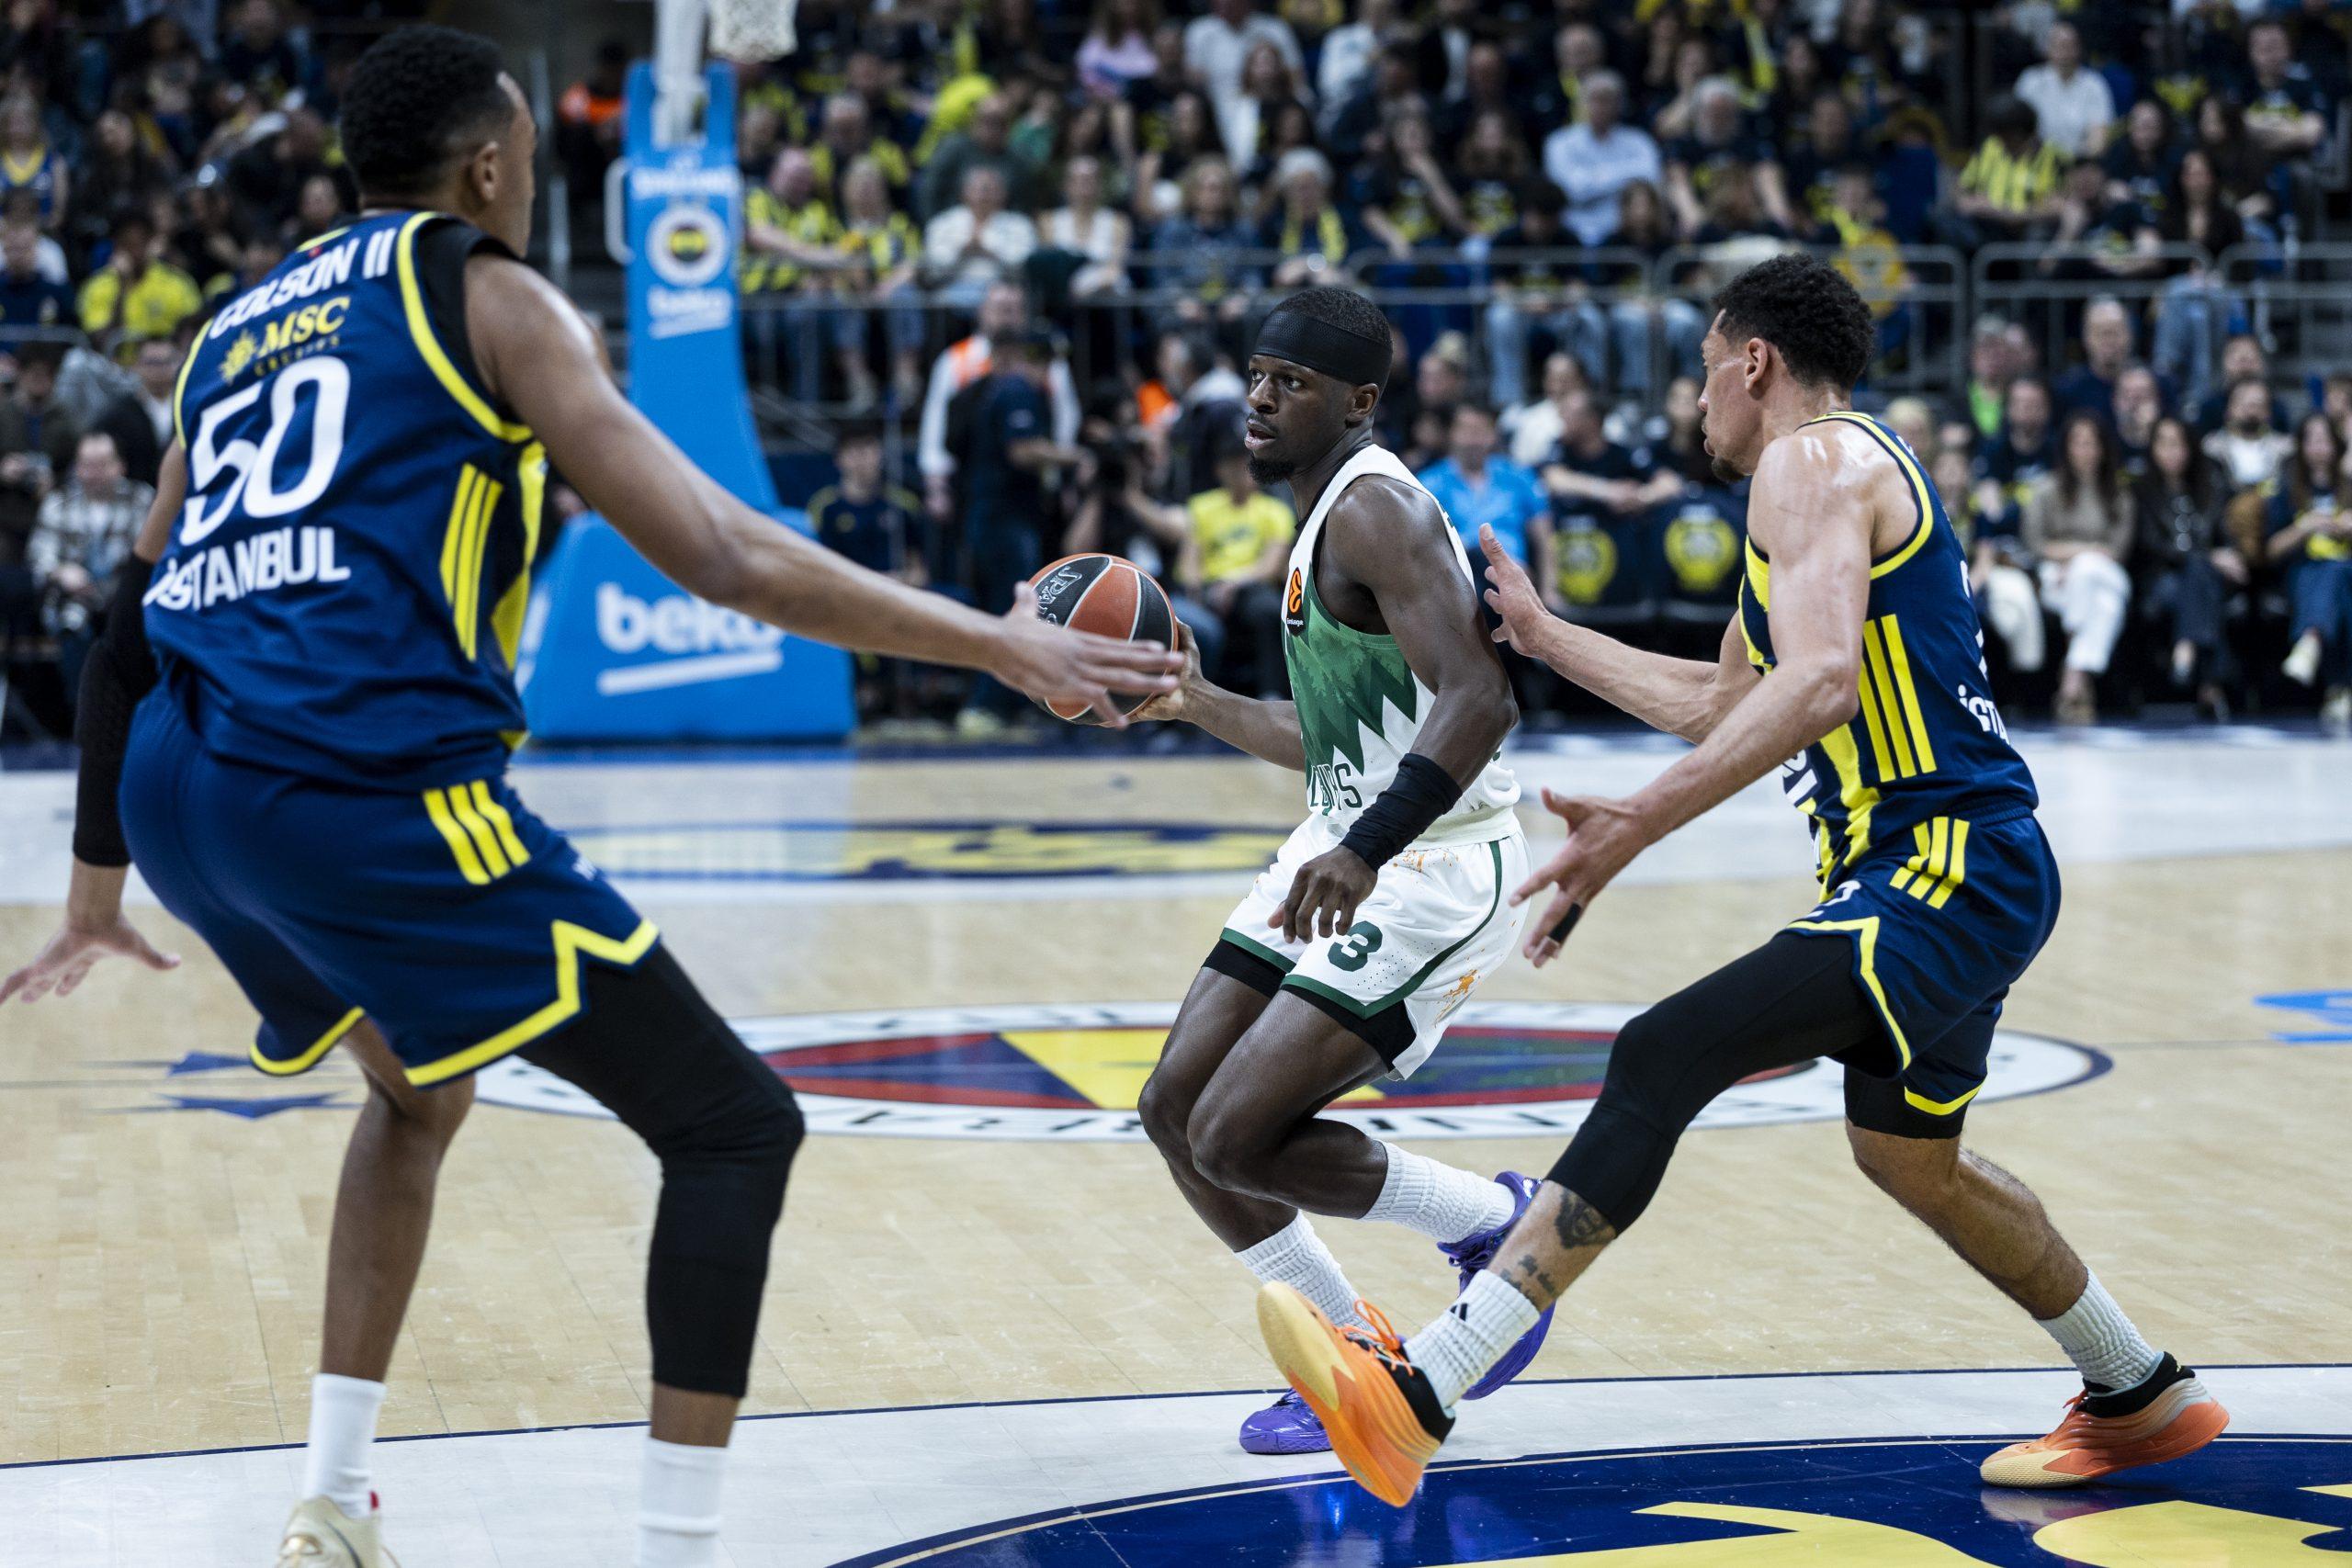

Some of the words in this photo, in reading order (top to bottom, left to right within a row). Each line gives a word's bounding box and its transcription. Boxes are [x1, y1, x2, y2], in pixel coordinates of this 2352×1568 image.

[209, 238, 360, 339] COLSON
[257, 297, 350, 357] MSC
[179, 355, 351, 547] 50
[1327, 920, 1384, 972] 3
